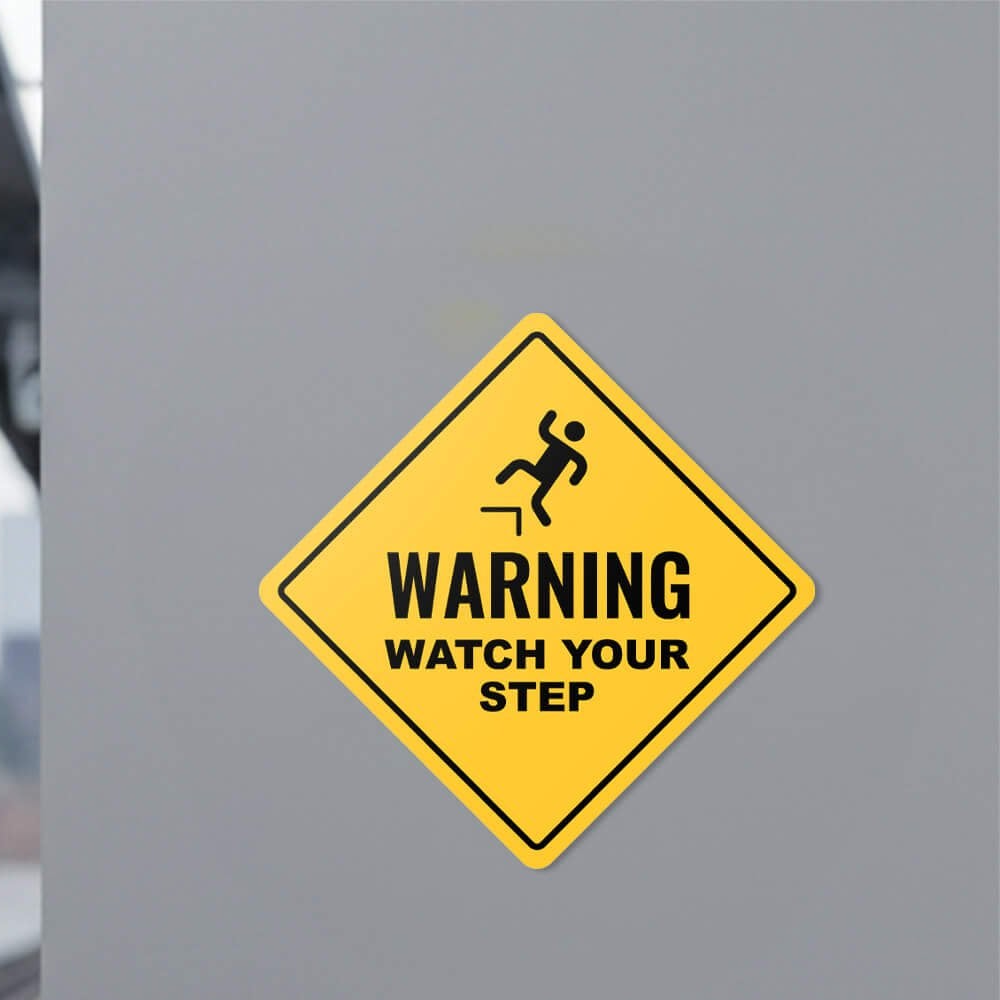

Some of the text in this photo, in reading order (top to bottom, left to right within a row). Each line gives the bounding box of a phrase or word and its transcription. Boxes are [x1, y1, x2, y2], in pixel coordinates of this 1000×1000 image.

[387, 551, 689, 619] WARNING
[385, 639, 689, 669] WATCH YOUR
[480, 681, 594, 712] STEP
